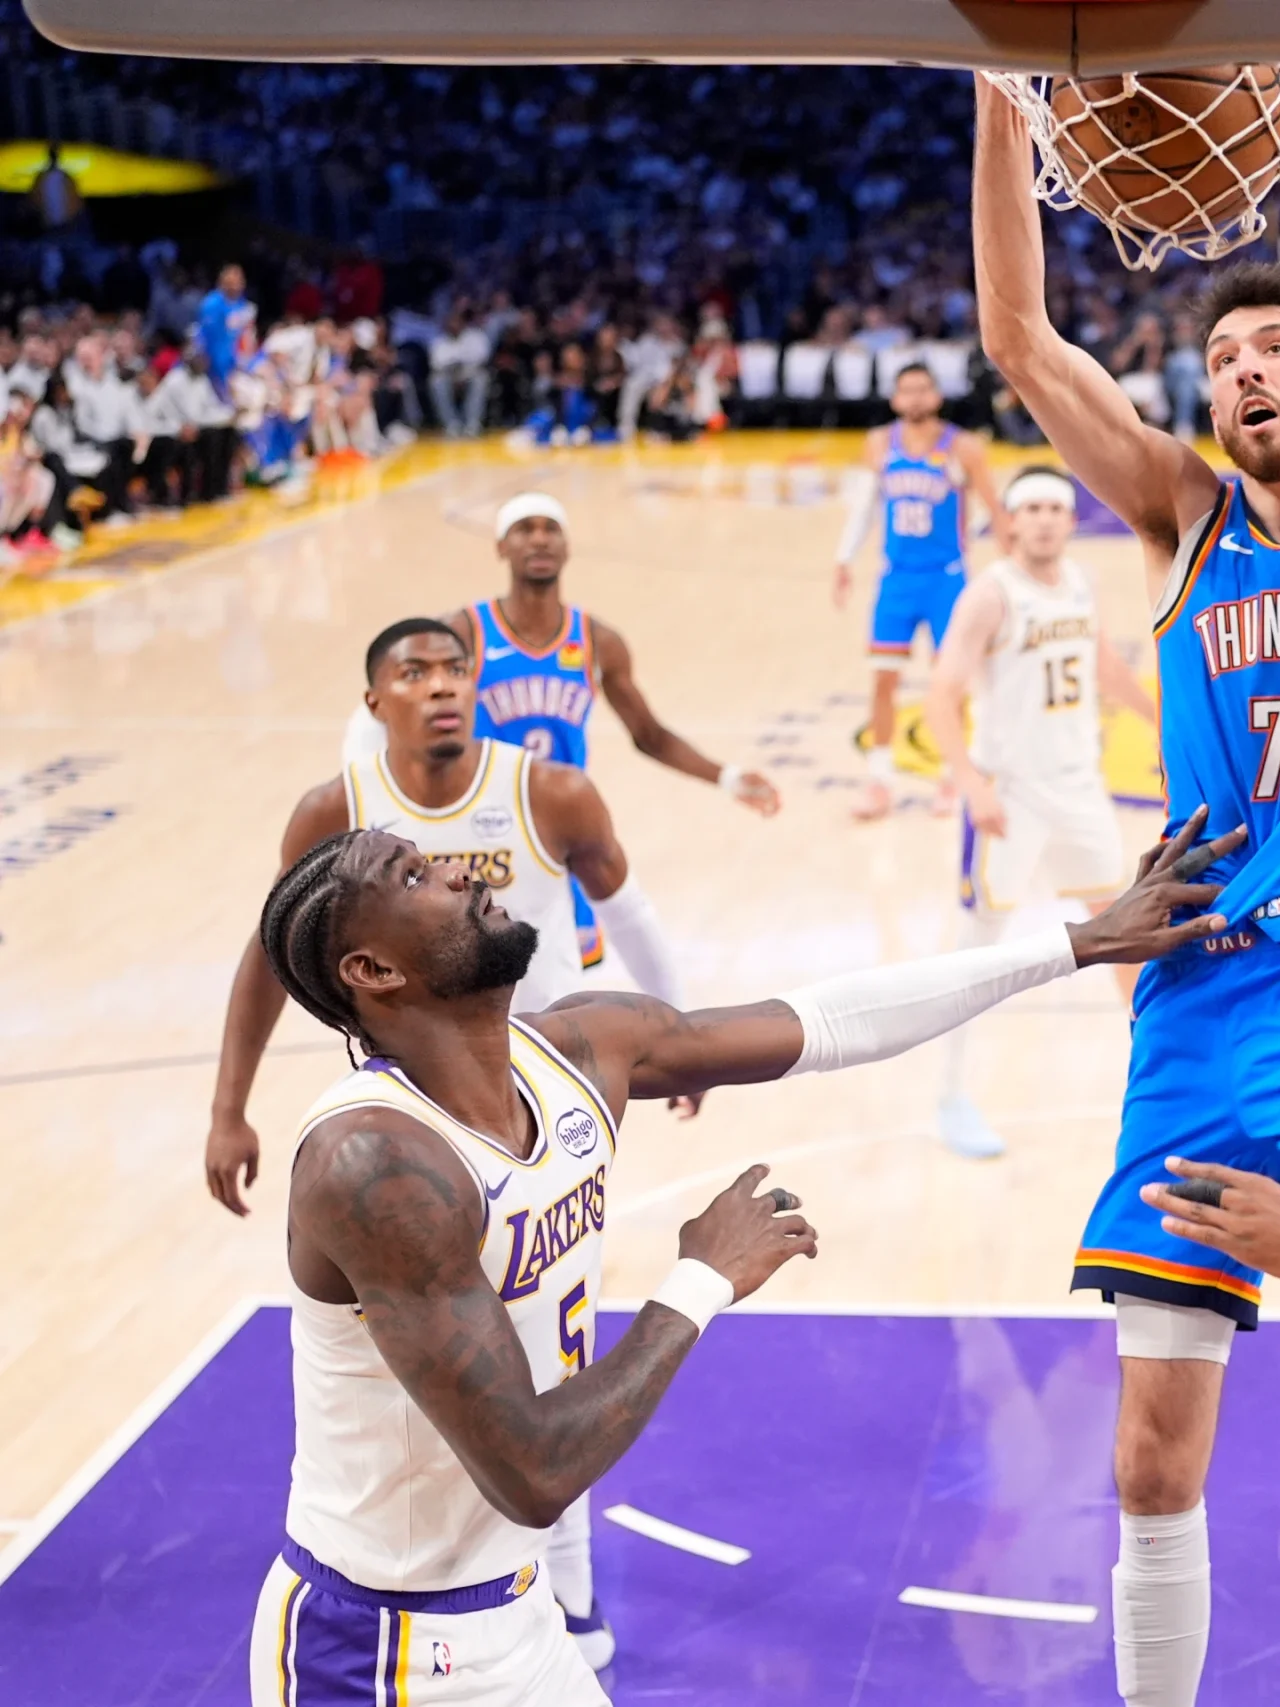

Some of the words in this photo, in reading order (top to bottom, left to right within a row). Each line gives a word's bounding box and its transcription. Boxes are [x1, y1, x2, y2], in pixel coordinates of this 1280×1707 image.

[1045, 655, 1080, 708] 15
[560, 1119, 593, 1146] bibigo
[498, 1163, 606, 1305] LAKERS
[558, 1276, 588, 1382] 5
